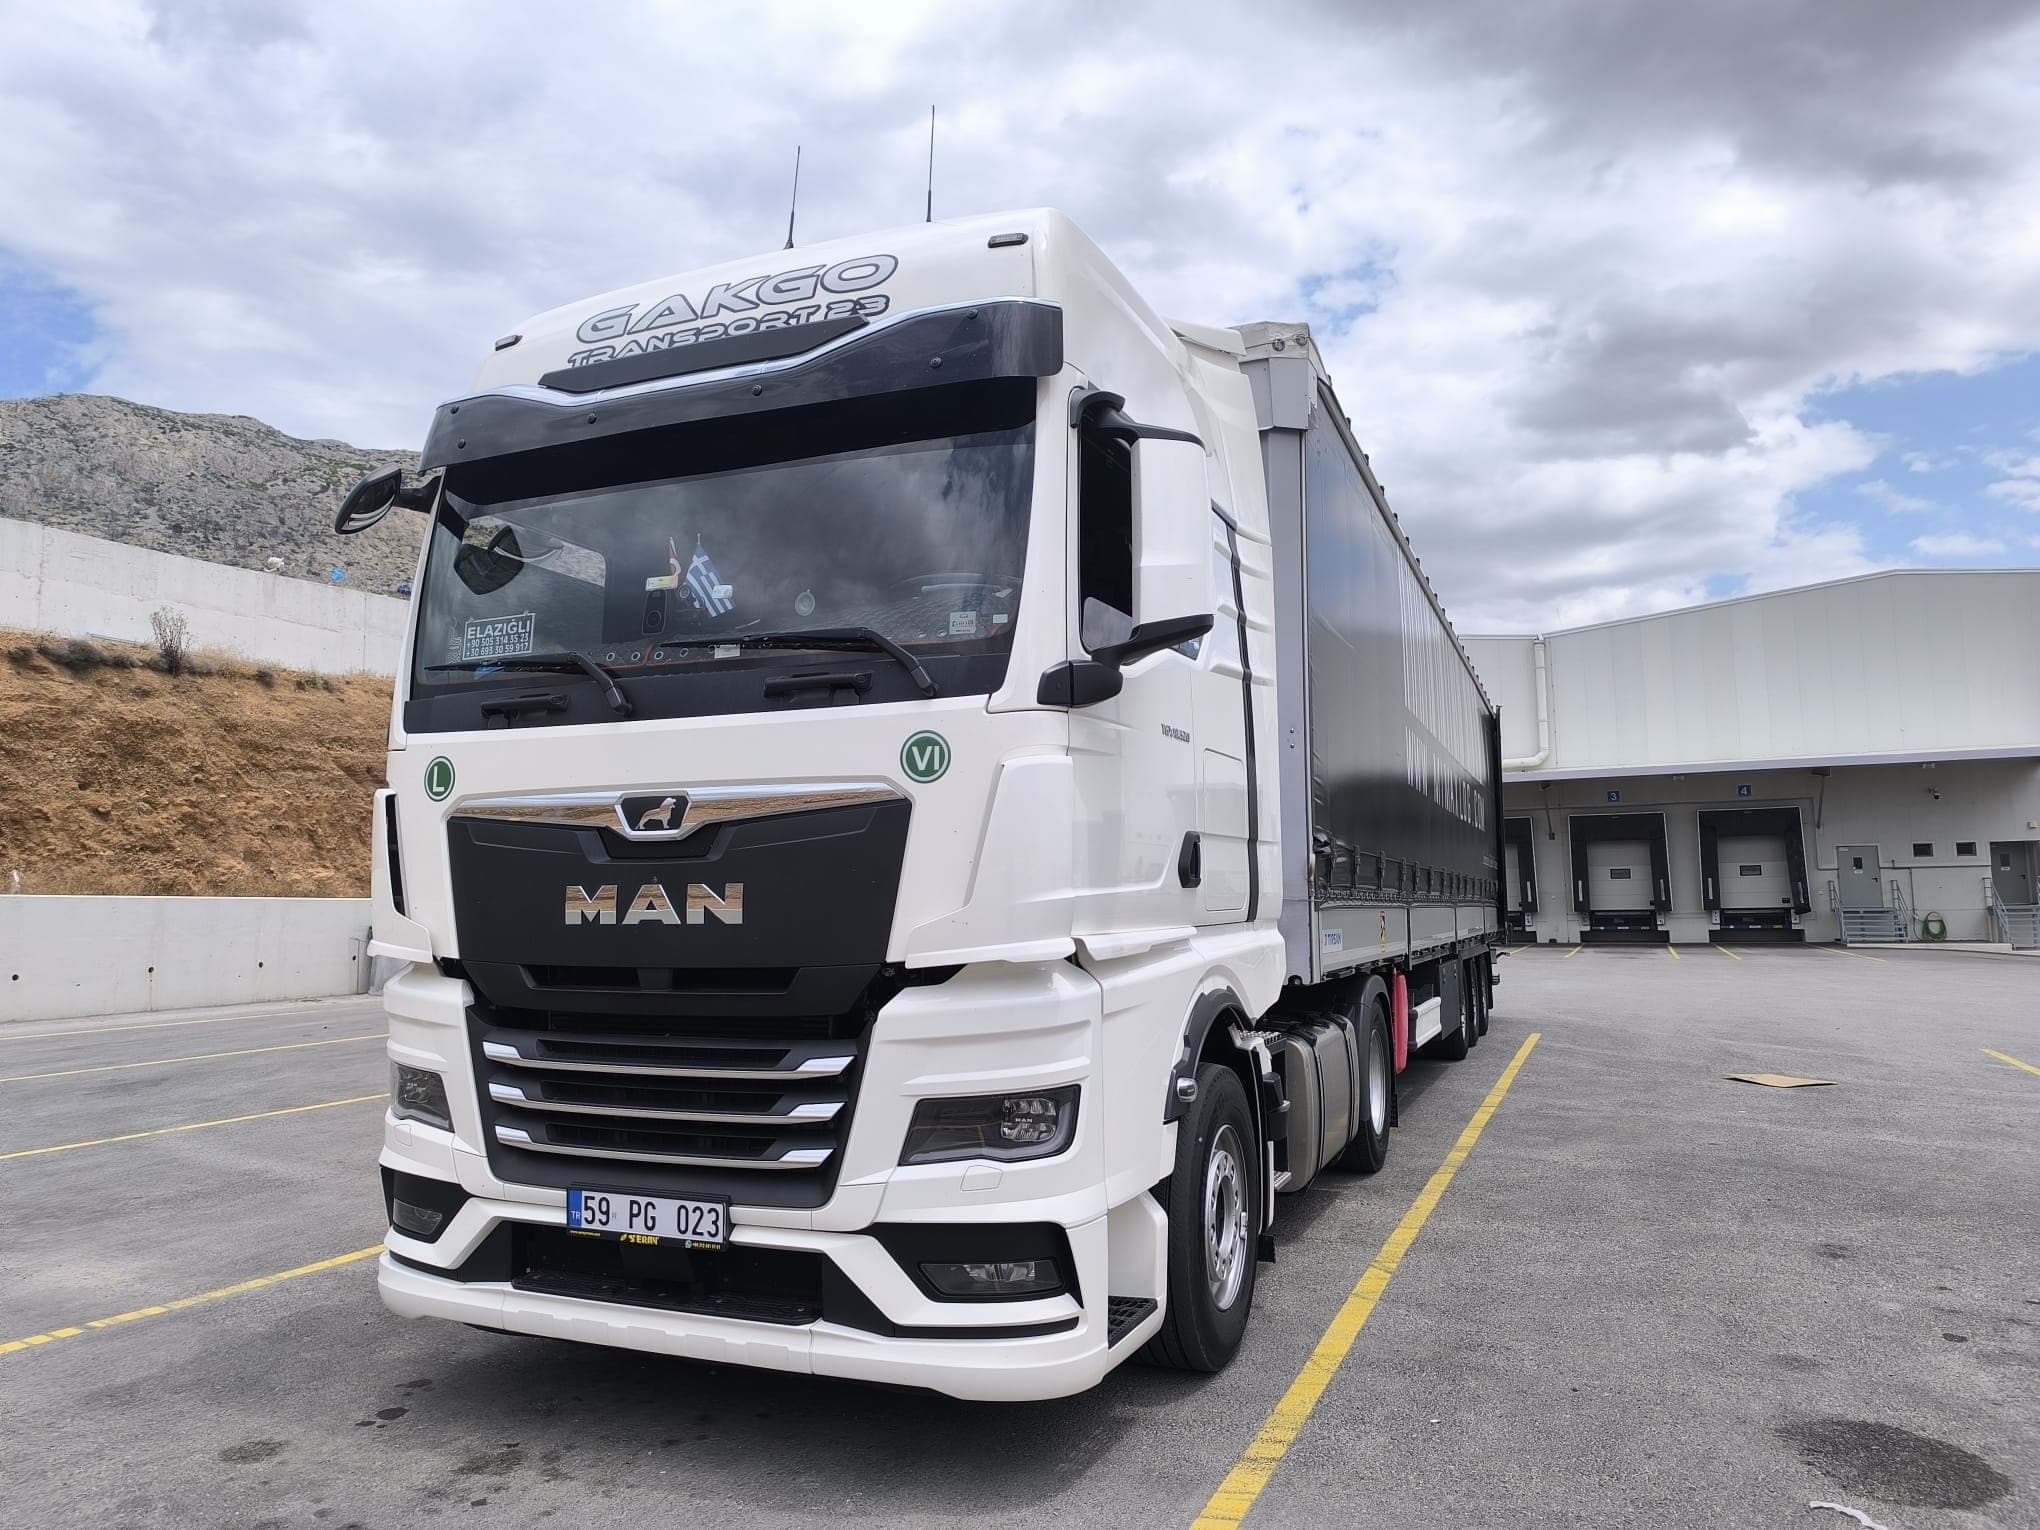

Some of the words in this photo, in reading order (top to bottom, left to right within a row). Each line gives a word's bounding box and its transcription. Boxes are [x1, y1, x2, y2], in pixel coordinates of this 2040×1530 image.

[576, 254, 899, 344] GAKGO
[481, 637, 494, 646] 505
[504, 644, 514, 653] 59
[911, 745, 940, 771] VI
[432, 765, 445, 793] L
[1610, 792, 1617, 800] 3
[1740, 787, 1748, 795] 4
[565, 882, 744, 925] MAN
[570, 1210, 581, 1221] TR
[583, 1195, 611, 1227] 59
[629, 1199, 657, 1232] PG
[676, 1204, 720, 1238] 023
